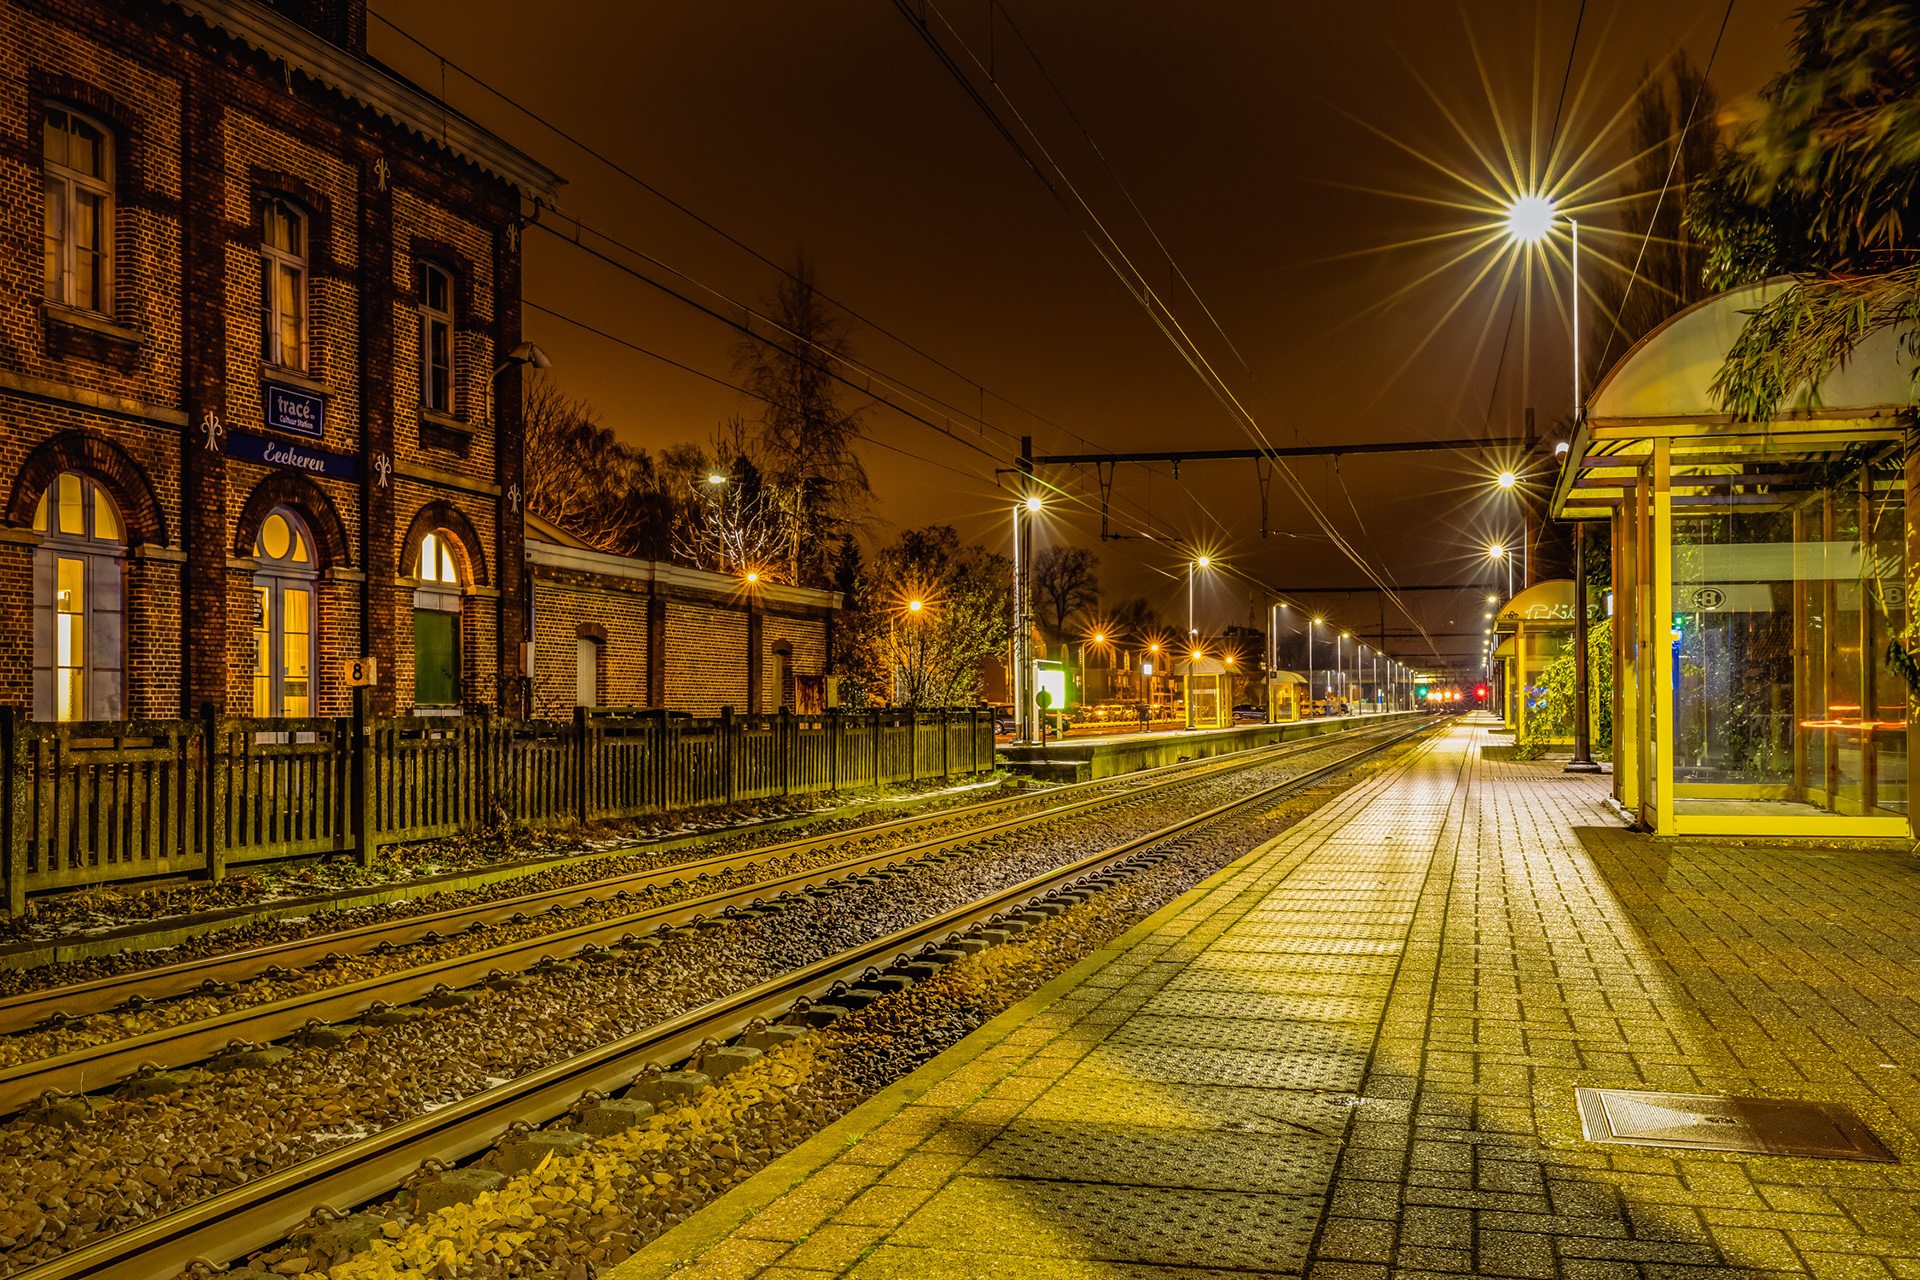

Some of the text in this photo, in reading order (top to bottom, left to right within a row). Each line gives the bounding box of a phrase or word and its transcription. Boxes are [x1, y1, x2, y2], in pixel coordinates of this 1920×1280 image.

[277, 395, 310, 418] tracé
[297, 419, 313, 429] Station
[263, 442, 325, 471] Eeckeren
[353, 663, 362, 680] 8
